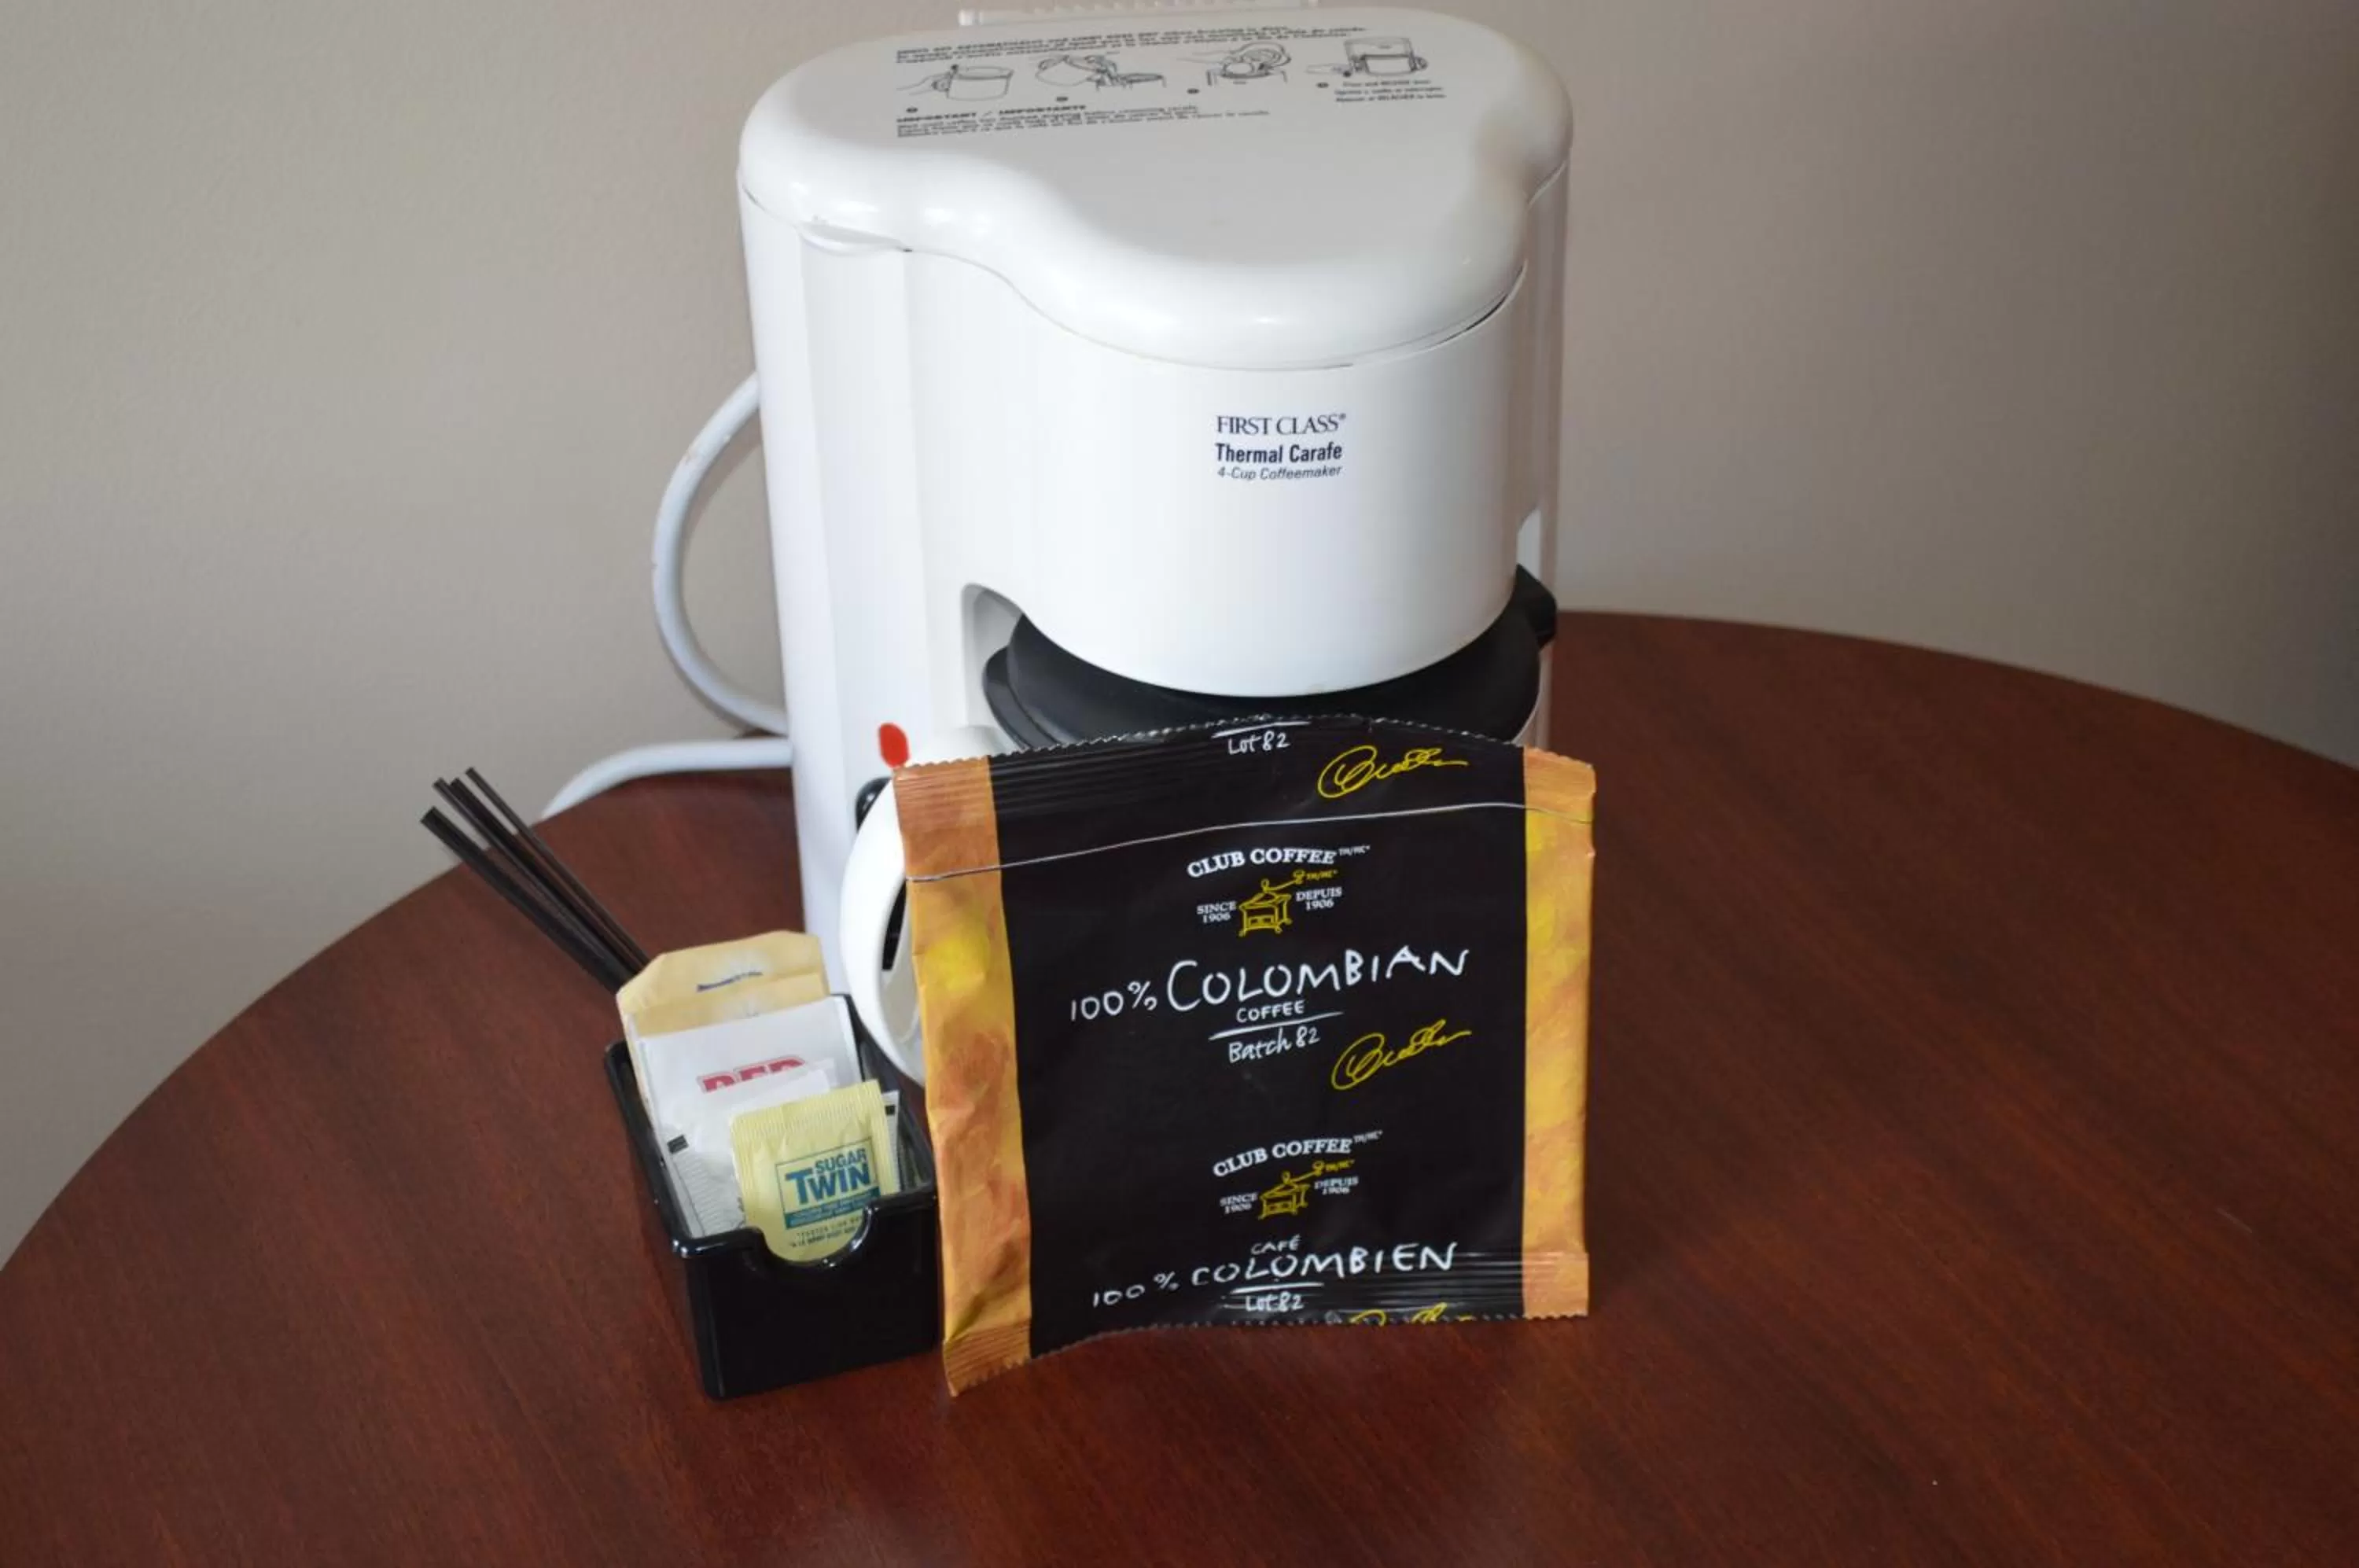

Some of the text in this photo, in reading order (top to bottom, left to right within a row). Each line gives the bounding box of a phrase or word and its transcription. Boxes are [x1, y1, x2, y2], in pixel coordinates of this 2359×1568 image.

[1216, 415, 1272, 435] FIRST
[1215, 441, 1342, 462] Thermal Carafe
[1217, 465, 1341, 480] 4-Cup Coffeemaker
[1261, 734, 1290, 751] 82
[1187, 851, 1246, 878] CLUB
[1249, 847, 1337, 865] COFFEE
[1296, 886, 1343, 902] DEPUIS
[1197, 900, 1237, 915] SINCE
[1305, 900, 1334, 911] 1906
[1202, 911, 1231, 923] 1906
[1070, 946, 1470, 1021] 100% COLOMBIAN
[1236, 999, 1305, 1023] COFFEE
[1229, 1027, 1321, 1063] Batch 82
[815, 1148, 867, 1174] SUGAR
[1213, 1147, 1268, 1177] CLUB
[1272, 1138, 1353, 1158] COFFEE
[785, 1163, 870, 1205] TWIN
[1220, 1192, 1258, 1207] SINCE
[1251, 1235, 1301, 1255] CAFÉ
[1191, 1242, 1456, 1286] COLOMBIEN
[1277, 1292, 1304, 1312] 82
